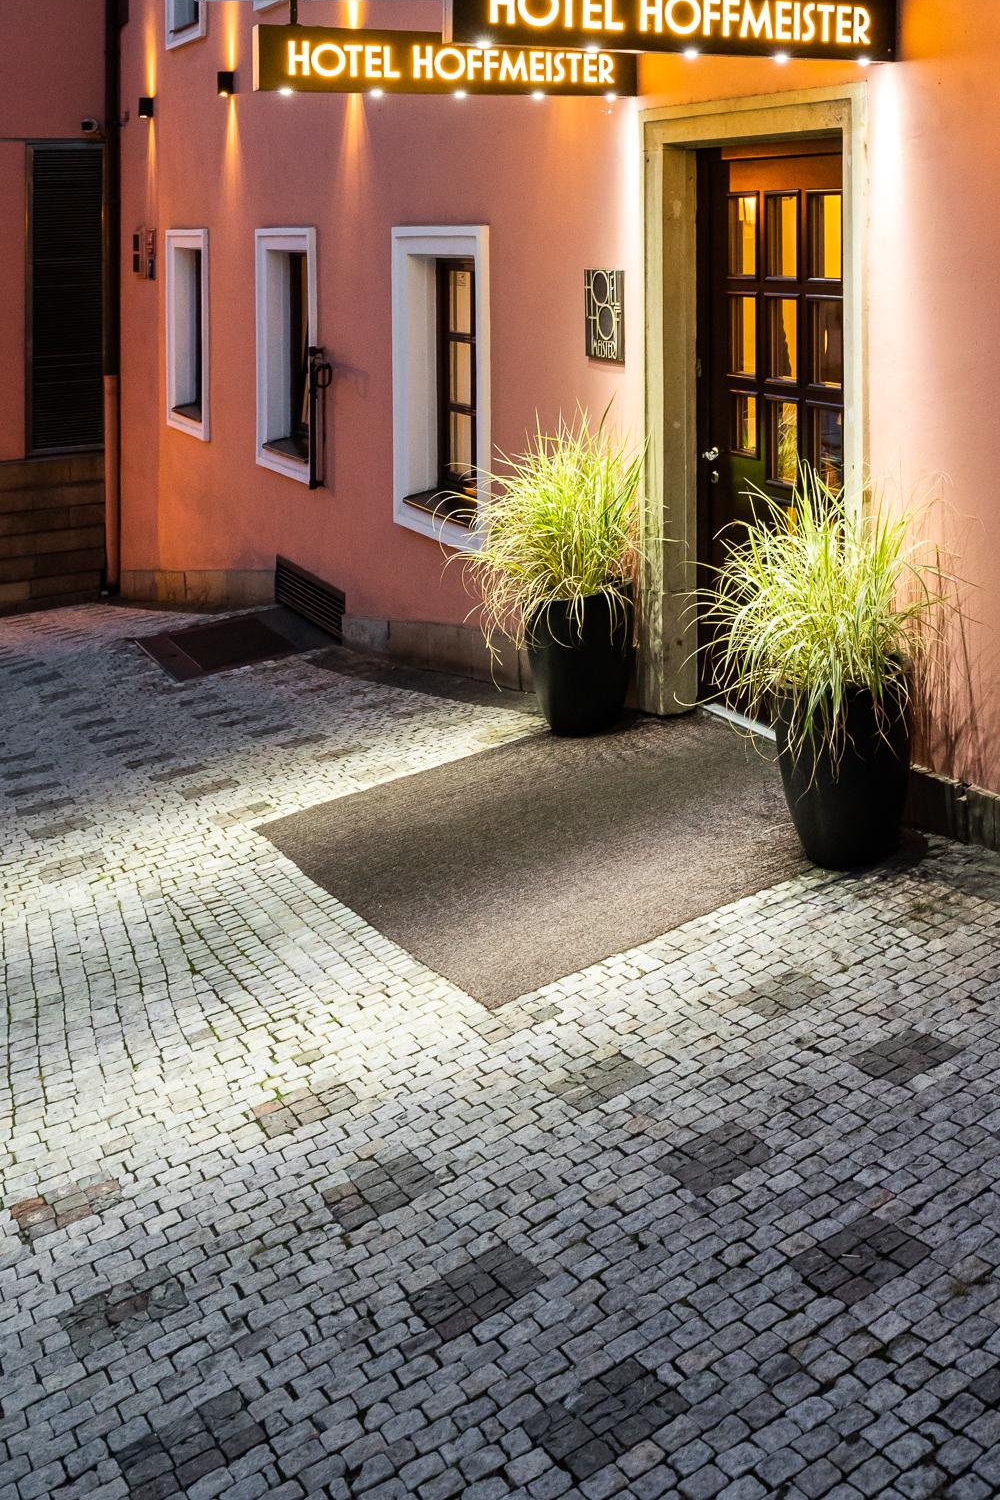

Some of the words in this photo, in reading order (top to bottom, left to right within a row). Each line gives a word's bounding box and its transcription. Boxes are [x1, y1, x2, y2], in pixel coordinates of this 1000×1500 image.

[287, 40, 401, 79] HOTEL
[412, 45, 615, 84] HOFFMEISTER
[584, 269, 620, 310] HOTEL
[592, 339, 617, 360] MEISTER
